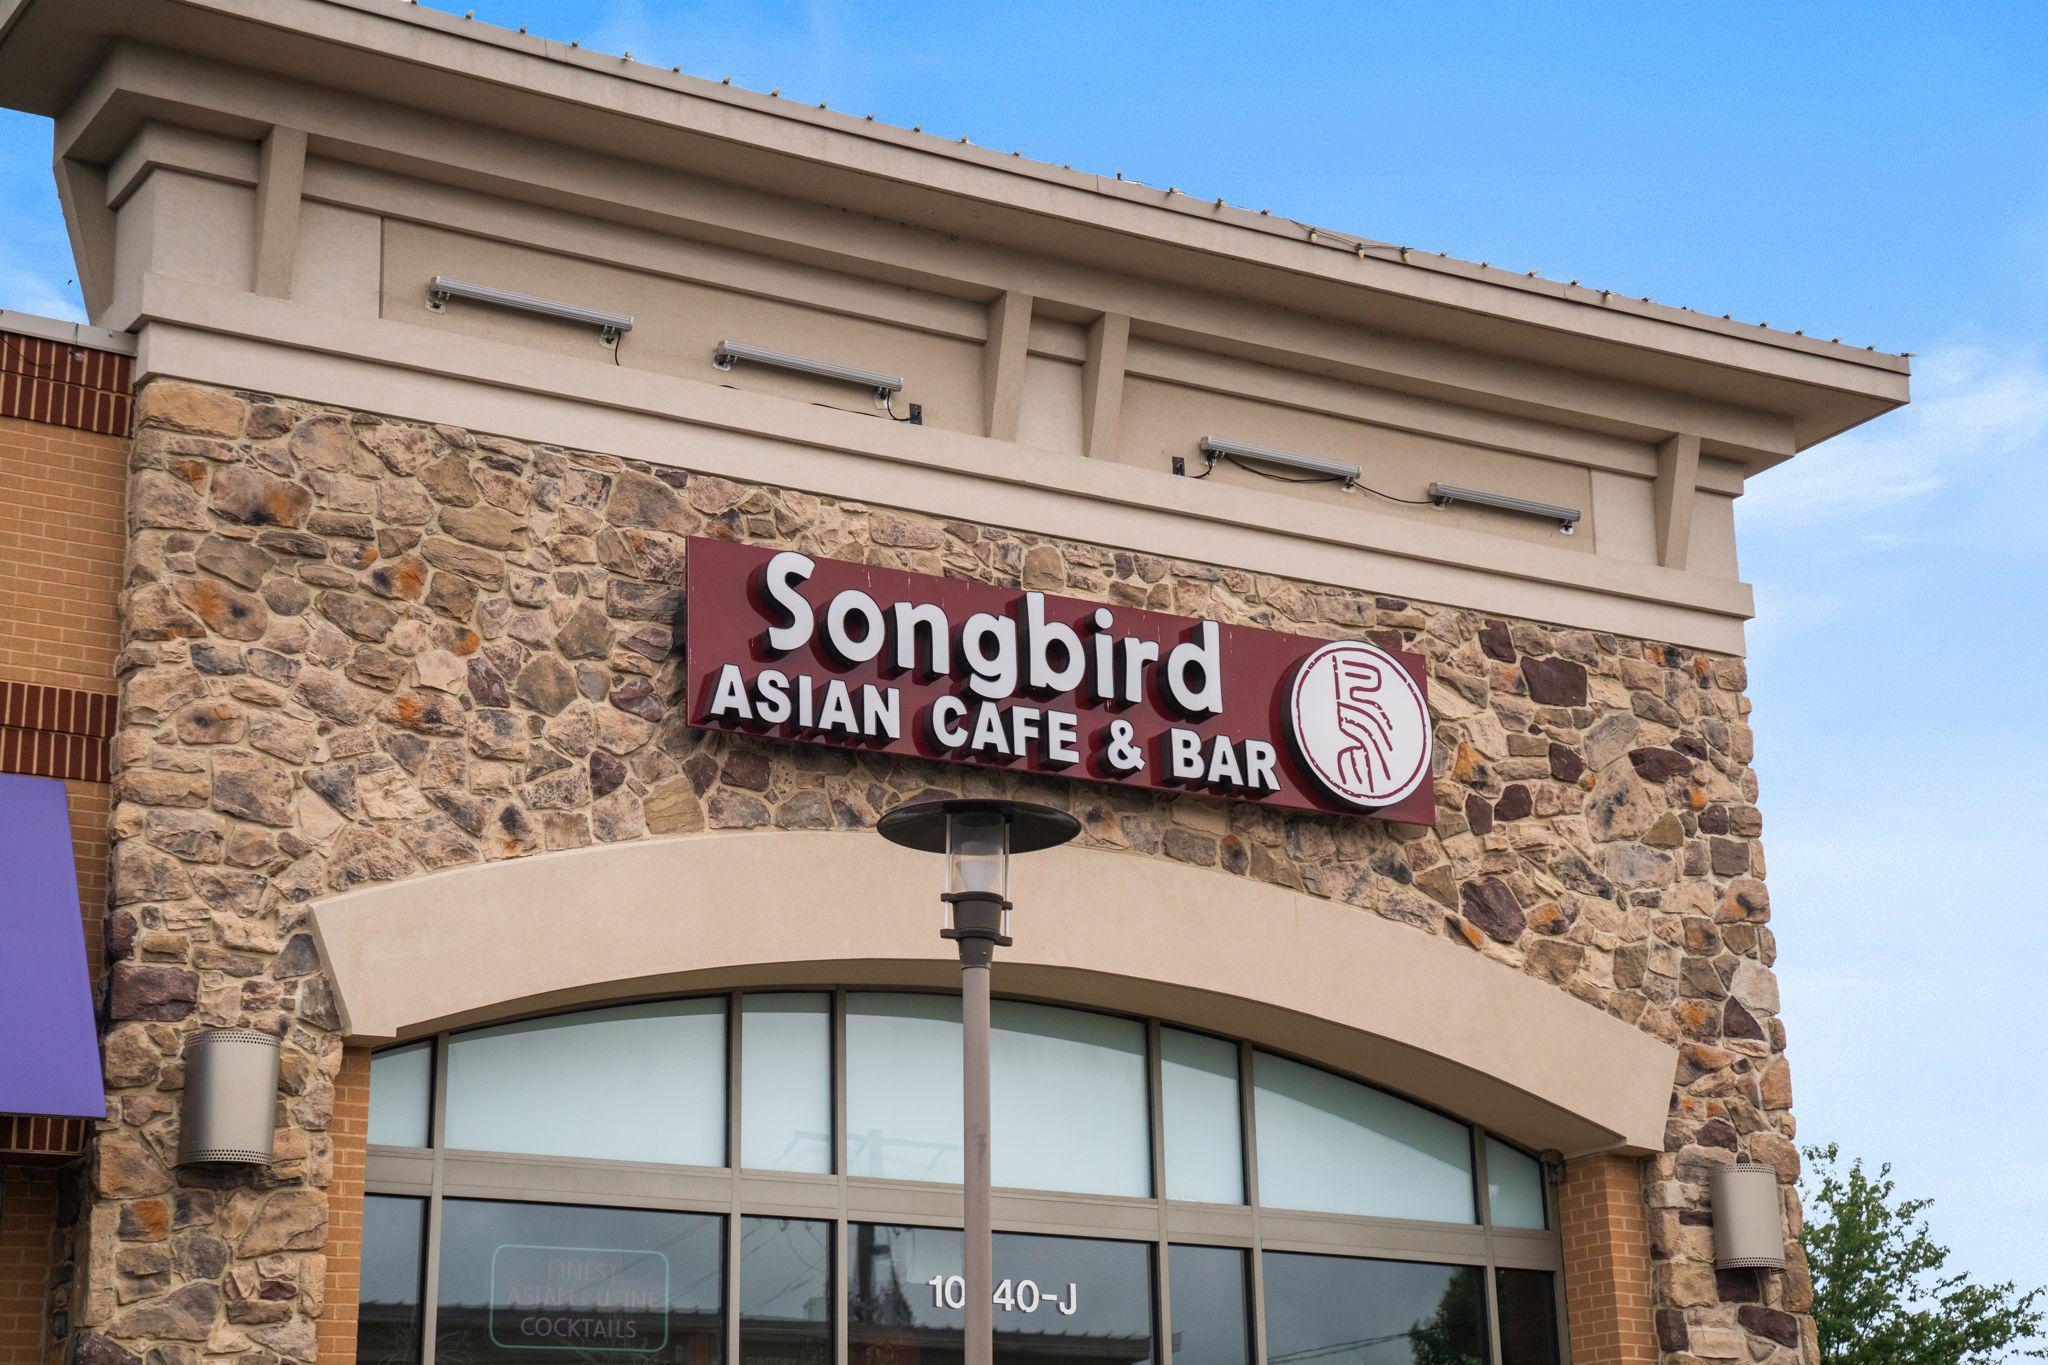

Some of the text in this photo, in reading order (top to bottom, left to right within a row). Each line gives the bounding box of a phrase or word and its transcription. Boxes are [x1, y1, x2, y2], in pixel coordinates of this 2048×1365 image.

[765, 551, 1223, 714] Songbird
[710, 663, 1282, 791] ASIAN CAFE & BAR
[520, 1316, 637, 1340] COCKTAILS
[929, 1274, 1077, 1316] 1040-J
